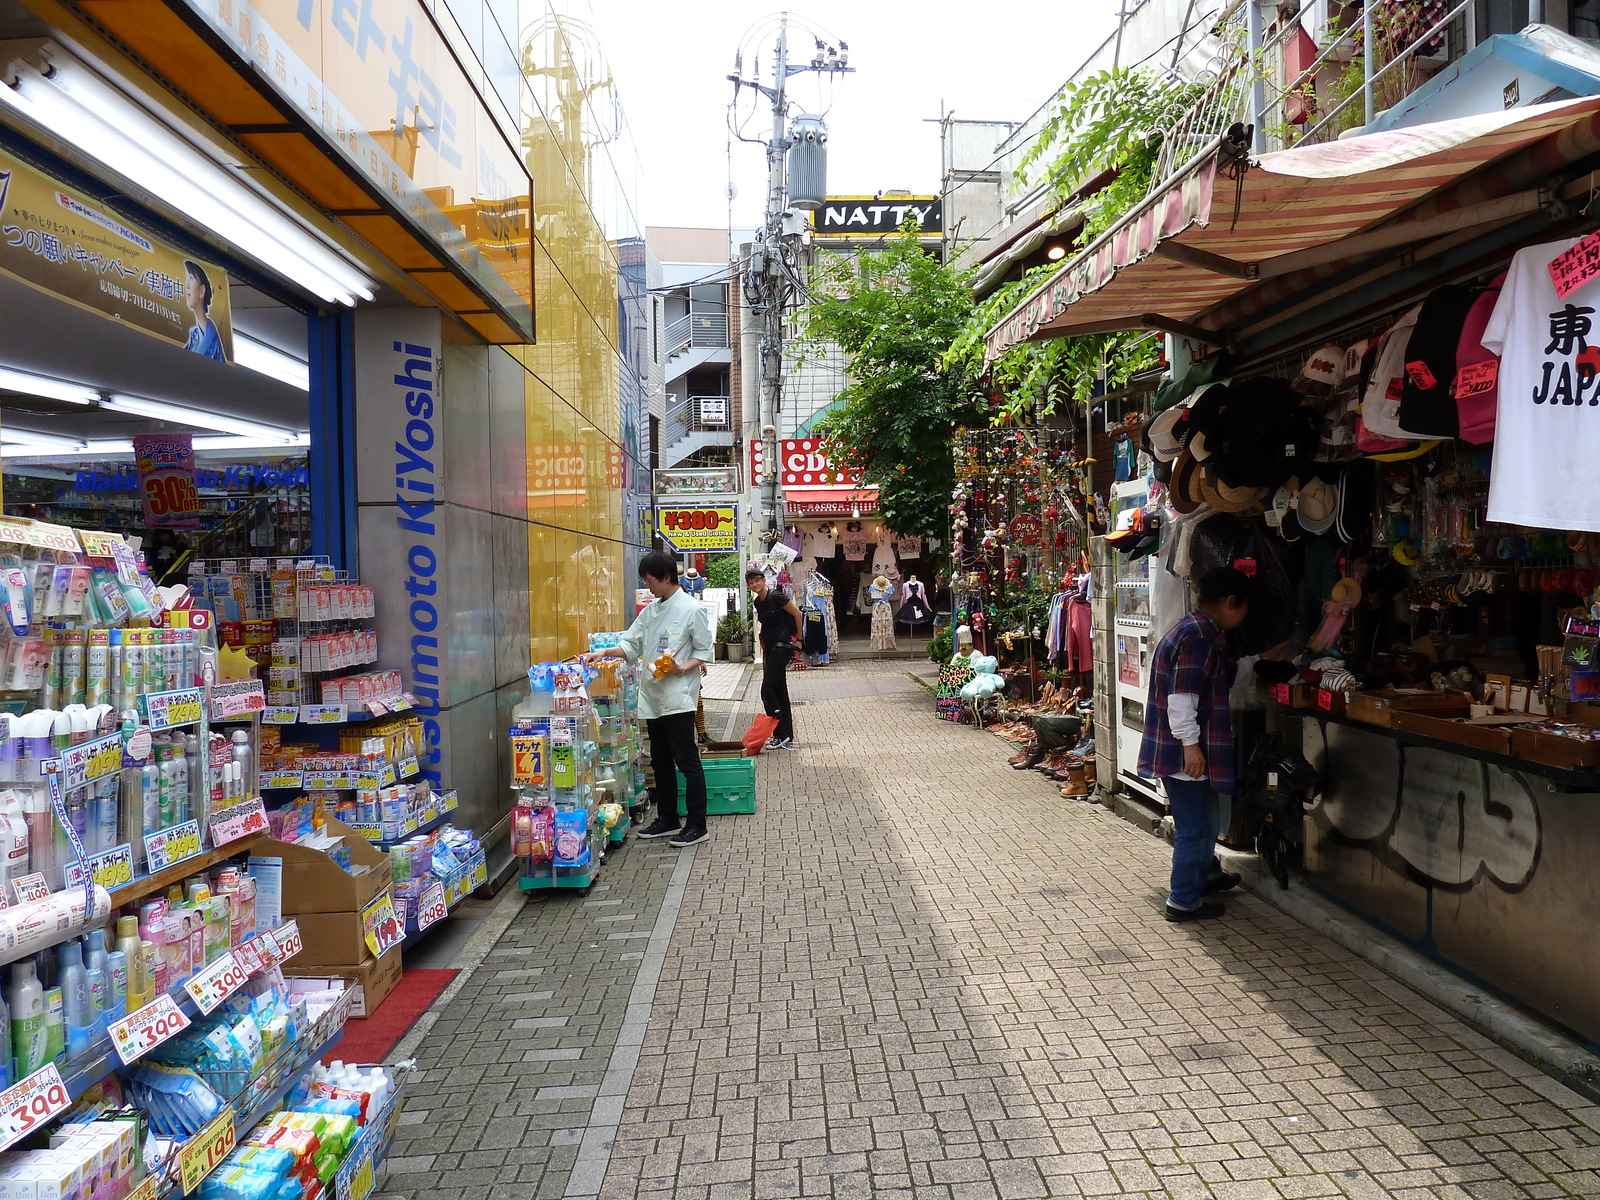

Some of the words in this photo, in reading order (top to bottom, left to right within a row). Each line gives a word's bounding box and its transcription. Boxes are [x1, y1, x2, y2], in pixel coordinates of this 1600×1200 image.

[824, 205, 932, 227] NATTY
[4, 226, 184, 300] つの願いキャンペーン実施中
[1544, 304, 1596, 355] 東
[394, 340, 436, 535] KiYoshi
[137, 441, 193, 458] カウンセリング
[153, 453, 178, 464] 化粧品
[146, 475, 197, 516] 30%
[183, 498, 199, 511] OFF
[814, 502, 838, 510] ACDC
[1017, 523, 1036, 531] OPEN
[46, 535, 77, 550] 980
[939, 669, 971, 681] PANAMA
[514, 741, 542, 752] サッサ
[166, 834, 199, 863] 399
[424, 903, 445, 924] 698
[375, 917, 397, 951] 199
[212, 966, 246, 998] 399
[140, 1012, 185, 1047] 399
[37, 1076, 60, 1093] 135+45g
[11, 1085, 67, 1131] 399
[207, 1126, 234, 1169] 199
[16, 1191, 33, 1199] Ban
